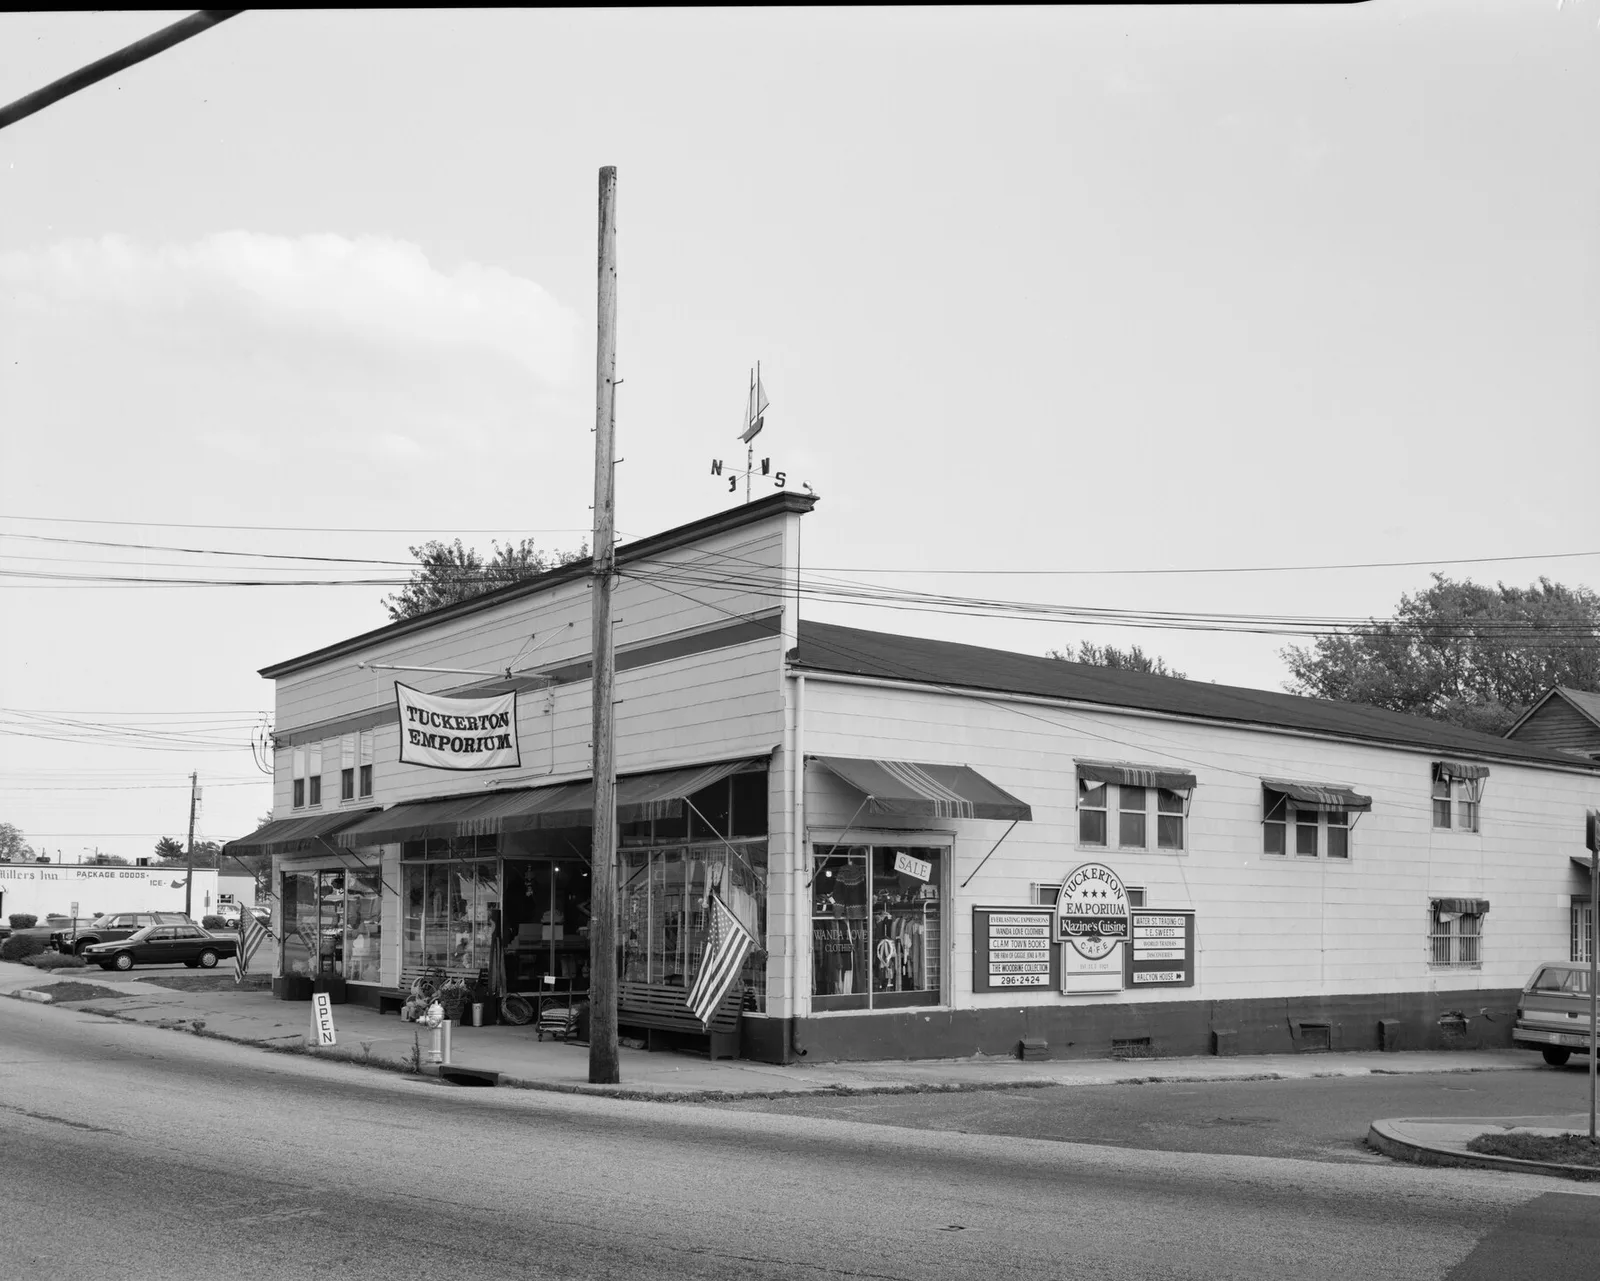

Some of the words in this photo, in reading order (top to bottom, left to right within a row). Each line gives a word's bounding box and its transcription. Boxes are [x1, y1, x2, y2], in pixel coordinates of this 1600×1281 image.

[406, 705, 509, 731] TUCKERTON
[408, 728, 512, 753] EMPORIUM
[899, 856, 928, 877] SALE
[40, 870, 58, 880] Inn
[76, 871, 115, 879] PACKAGE
[1063, 867, 1123, 900] TUCKERTON
[1066, 902, 1126, 915] EMPORIUM
[990, 916, 1020, 924] EVERLASTING
[1021, 916, 1049, 924] EXPRESSIONS
[1136, 917, 1151, 925] WATER
[1158, 917, 1177, 926] TRADING
[996, 927, 1012, 935] WANDA
[1013, 927, 1024, 935] LOVE
[1061, 919, 1098, 936] Klazine's
[1098, 919, 1127, 936] Cuisine
[1155, 928, 1175, 937] SWEETS
[813, 929, 844, 940] WANDA
[993, 940, 1009, 948] CLAM
[1011, 940, 1027, 948] TOWN
[1028, 940, 1046, 948] BOOKS
[992, 964, 1001, 972] THE
[1024, 963, 1048, 972] COLLECTION
[1136, 973, 1158, 981] HALCYON
[1159, 972, 1174, 981] HOUSE
[317, 995, 333, 1044] OPEN
